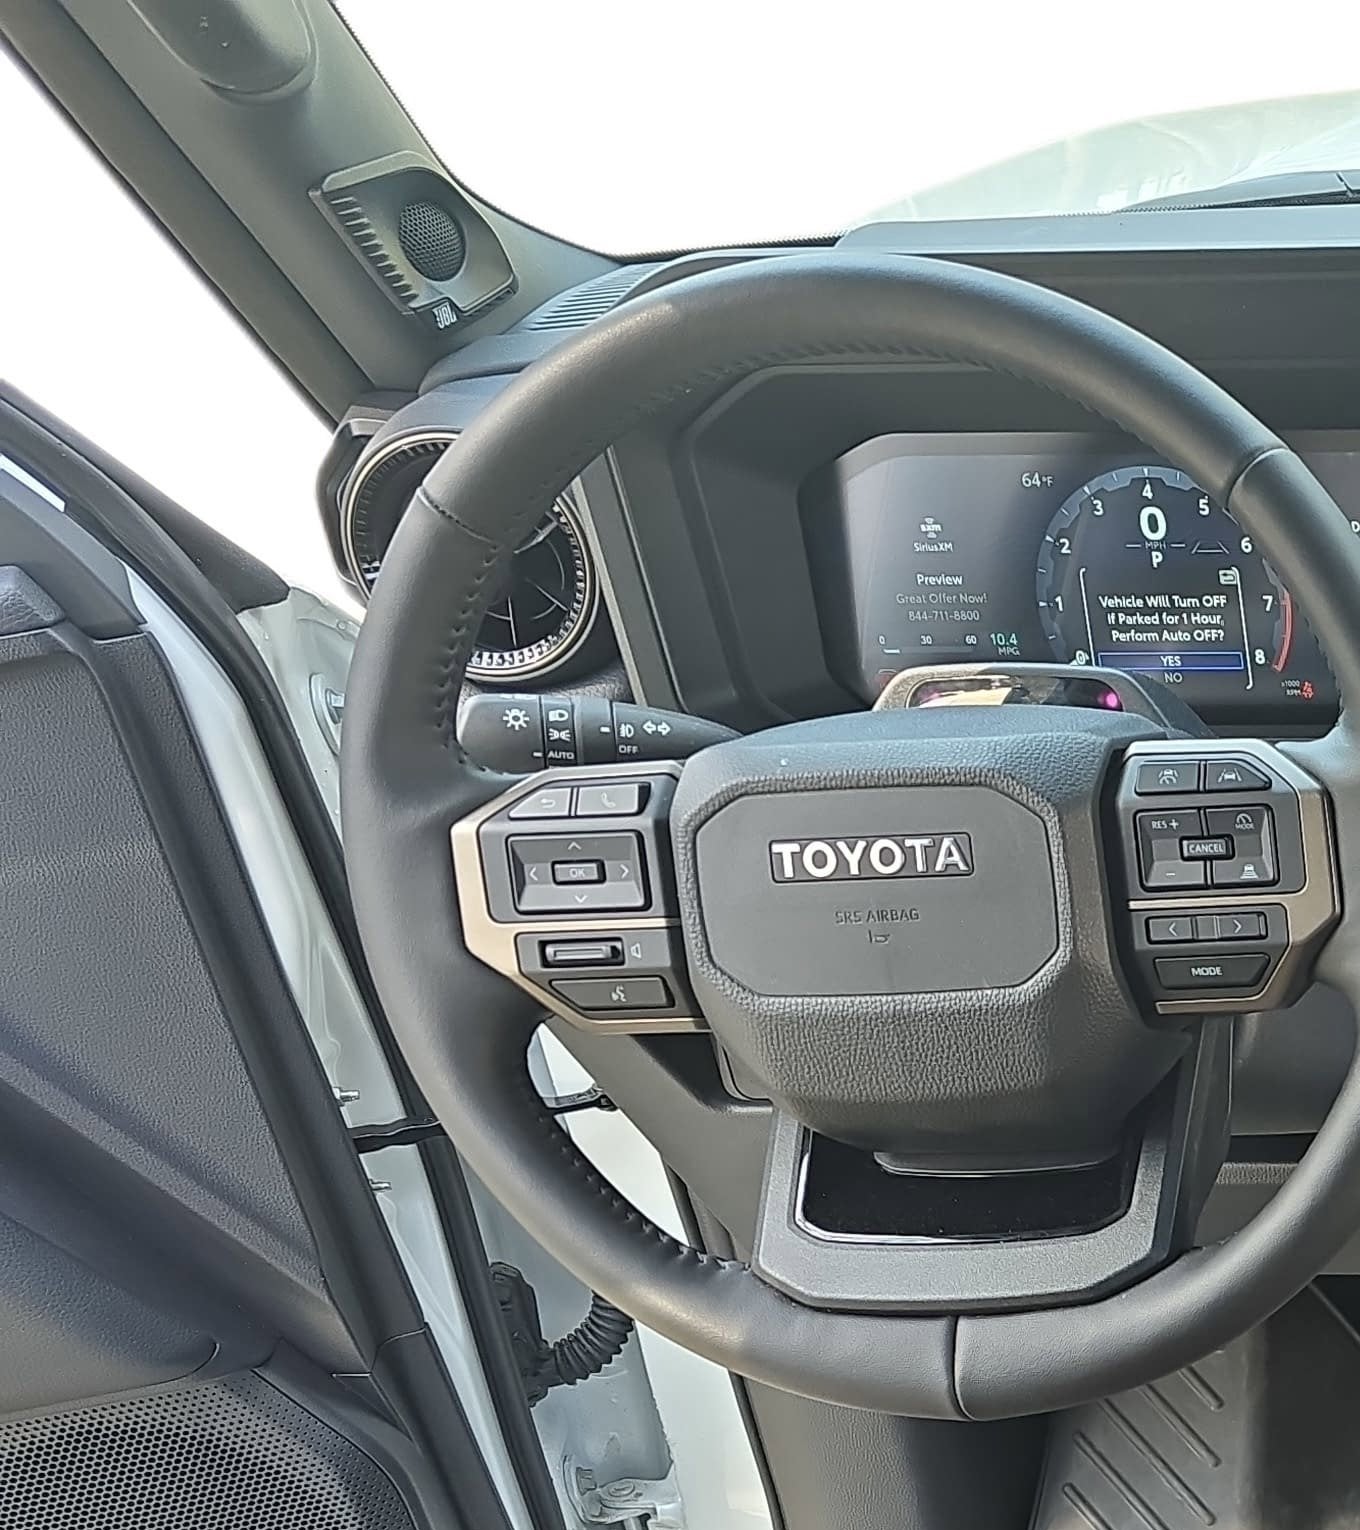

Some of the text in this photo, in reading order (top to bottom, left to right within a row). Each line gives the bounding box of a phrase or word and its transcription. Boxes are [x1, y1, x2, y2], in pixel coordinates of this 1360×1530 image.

[1142, 484, 1153, 500] 4
[1093, 500, 1104, 516] 3
[1199, 499, 1210, 515] 5
[1139, 506, 1167, 541] 0
[914, 542, 953, 553] SiriusXM
[1059, 538, 1072, 554] 2
[1240, 537, 1252, 553] 6
[1152, 552, 1163, 568] P
[917, 573, 963, 586] Preview
[896, 593, 988, 604] Great Offer Now!
[1054, 595, 1064, 612] 1
[1099, 595, 1227, 608] Vehicle Will Turn OFF
[1262, 595, 1273, 612] 7
[909, 610, 980, 621] 844-711-8800
[1107, 612, 1117, 625] If
[1118, 612, 1160, 625] Parked
[1162, 612, 1180, 625] for
[1182, 612, 1188, 625] 1
[879, 635, 978, 645] 0 30 60
[990, 633, 1018, 646] 10.4
[1111, 629, 1225, 643] Perform Auto OFF?
[998, 647, 1020, 656] MPG
[1076, 650, 1086, 665] 0
[1255, 649, 1266, 665] 8
[1160, 655, 1182, 667] YES
[1164, 671, 1183, 684] NO
[547, 750, 575, 760] AUTO
[618, 744, 639, 754] OFF
[1151, 820, 1168, 830] RES
[1188, 842, 1224, 854] CANCEL
[771, 837, 970, 880] TOYOTA
[569, 867, 586, 879] OK
[835, 907, 920, 925] SRS AIRBAG
[1190, 966, 1223, 977] MODE
